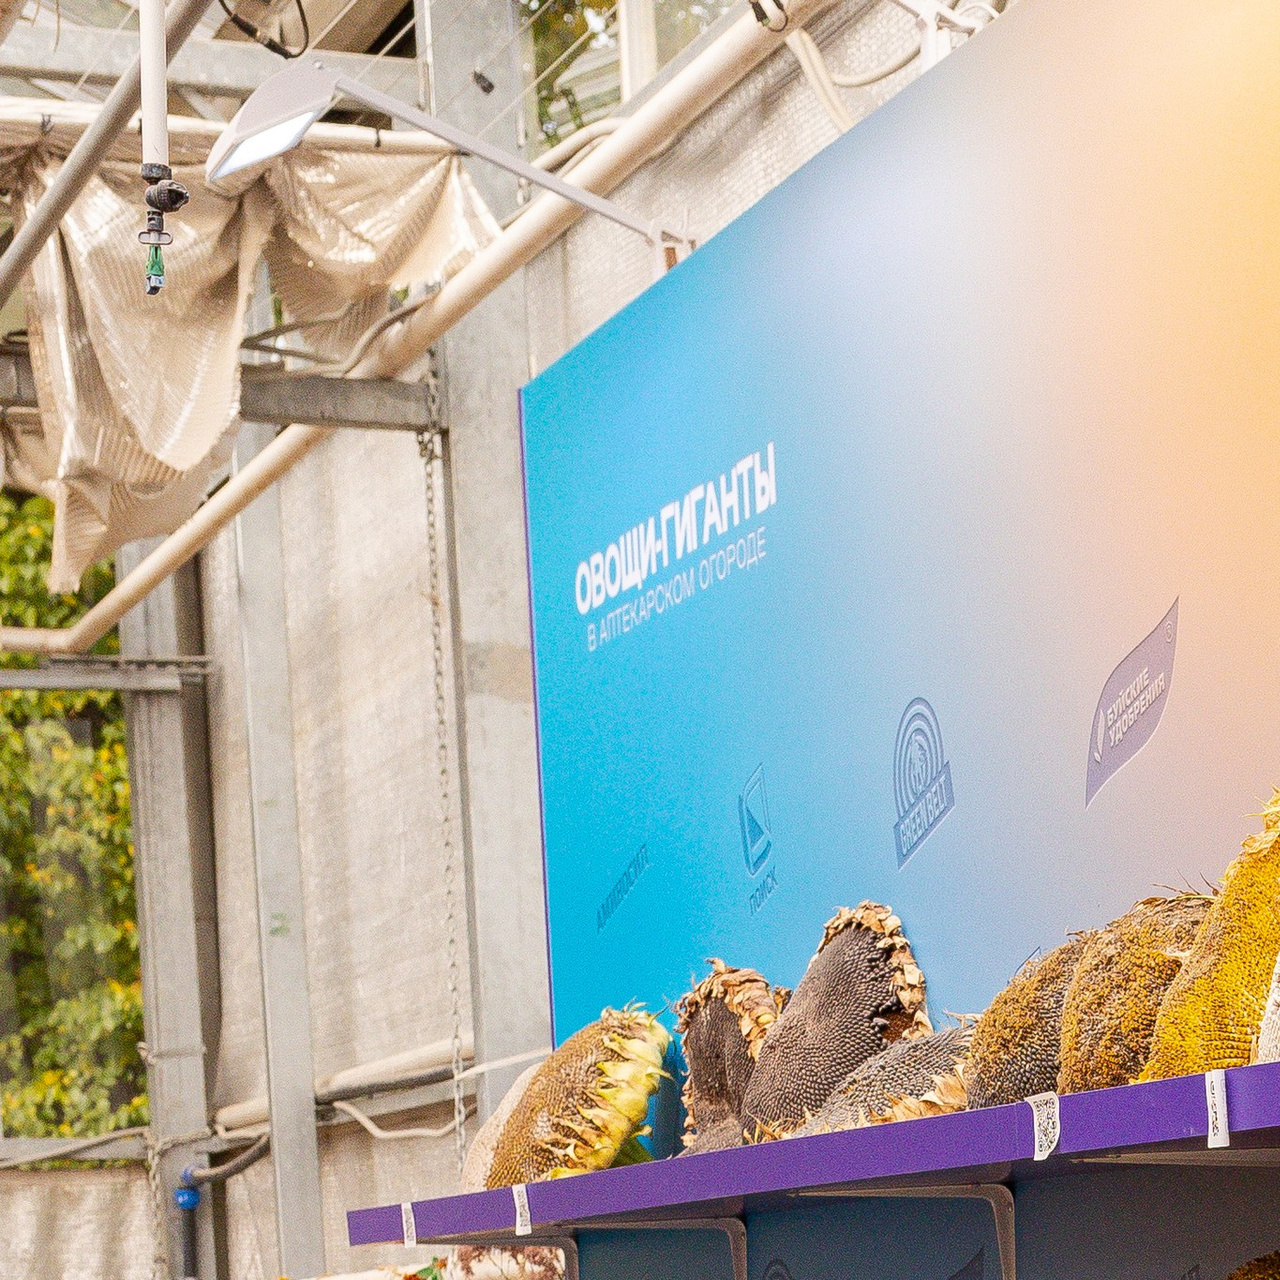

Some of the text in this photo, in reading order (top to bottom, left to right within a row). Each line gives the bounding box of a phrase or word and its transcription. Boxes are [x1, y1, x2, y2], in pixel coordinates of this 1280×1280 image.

[575, 440, 777, 615] ОВОЩИ-ГИГАНТЫ
[587, 526, 767, 651] В АПТЕКАРСКОМ ОГОРОДЕ
[1106, 667, 1150, 728] БУЙСКИЕ
[1108, 672, 1166, 748] УДОБРЕНИЯ
